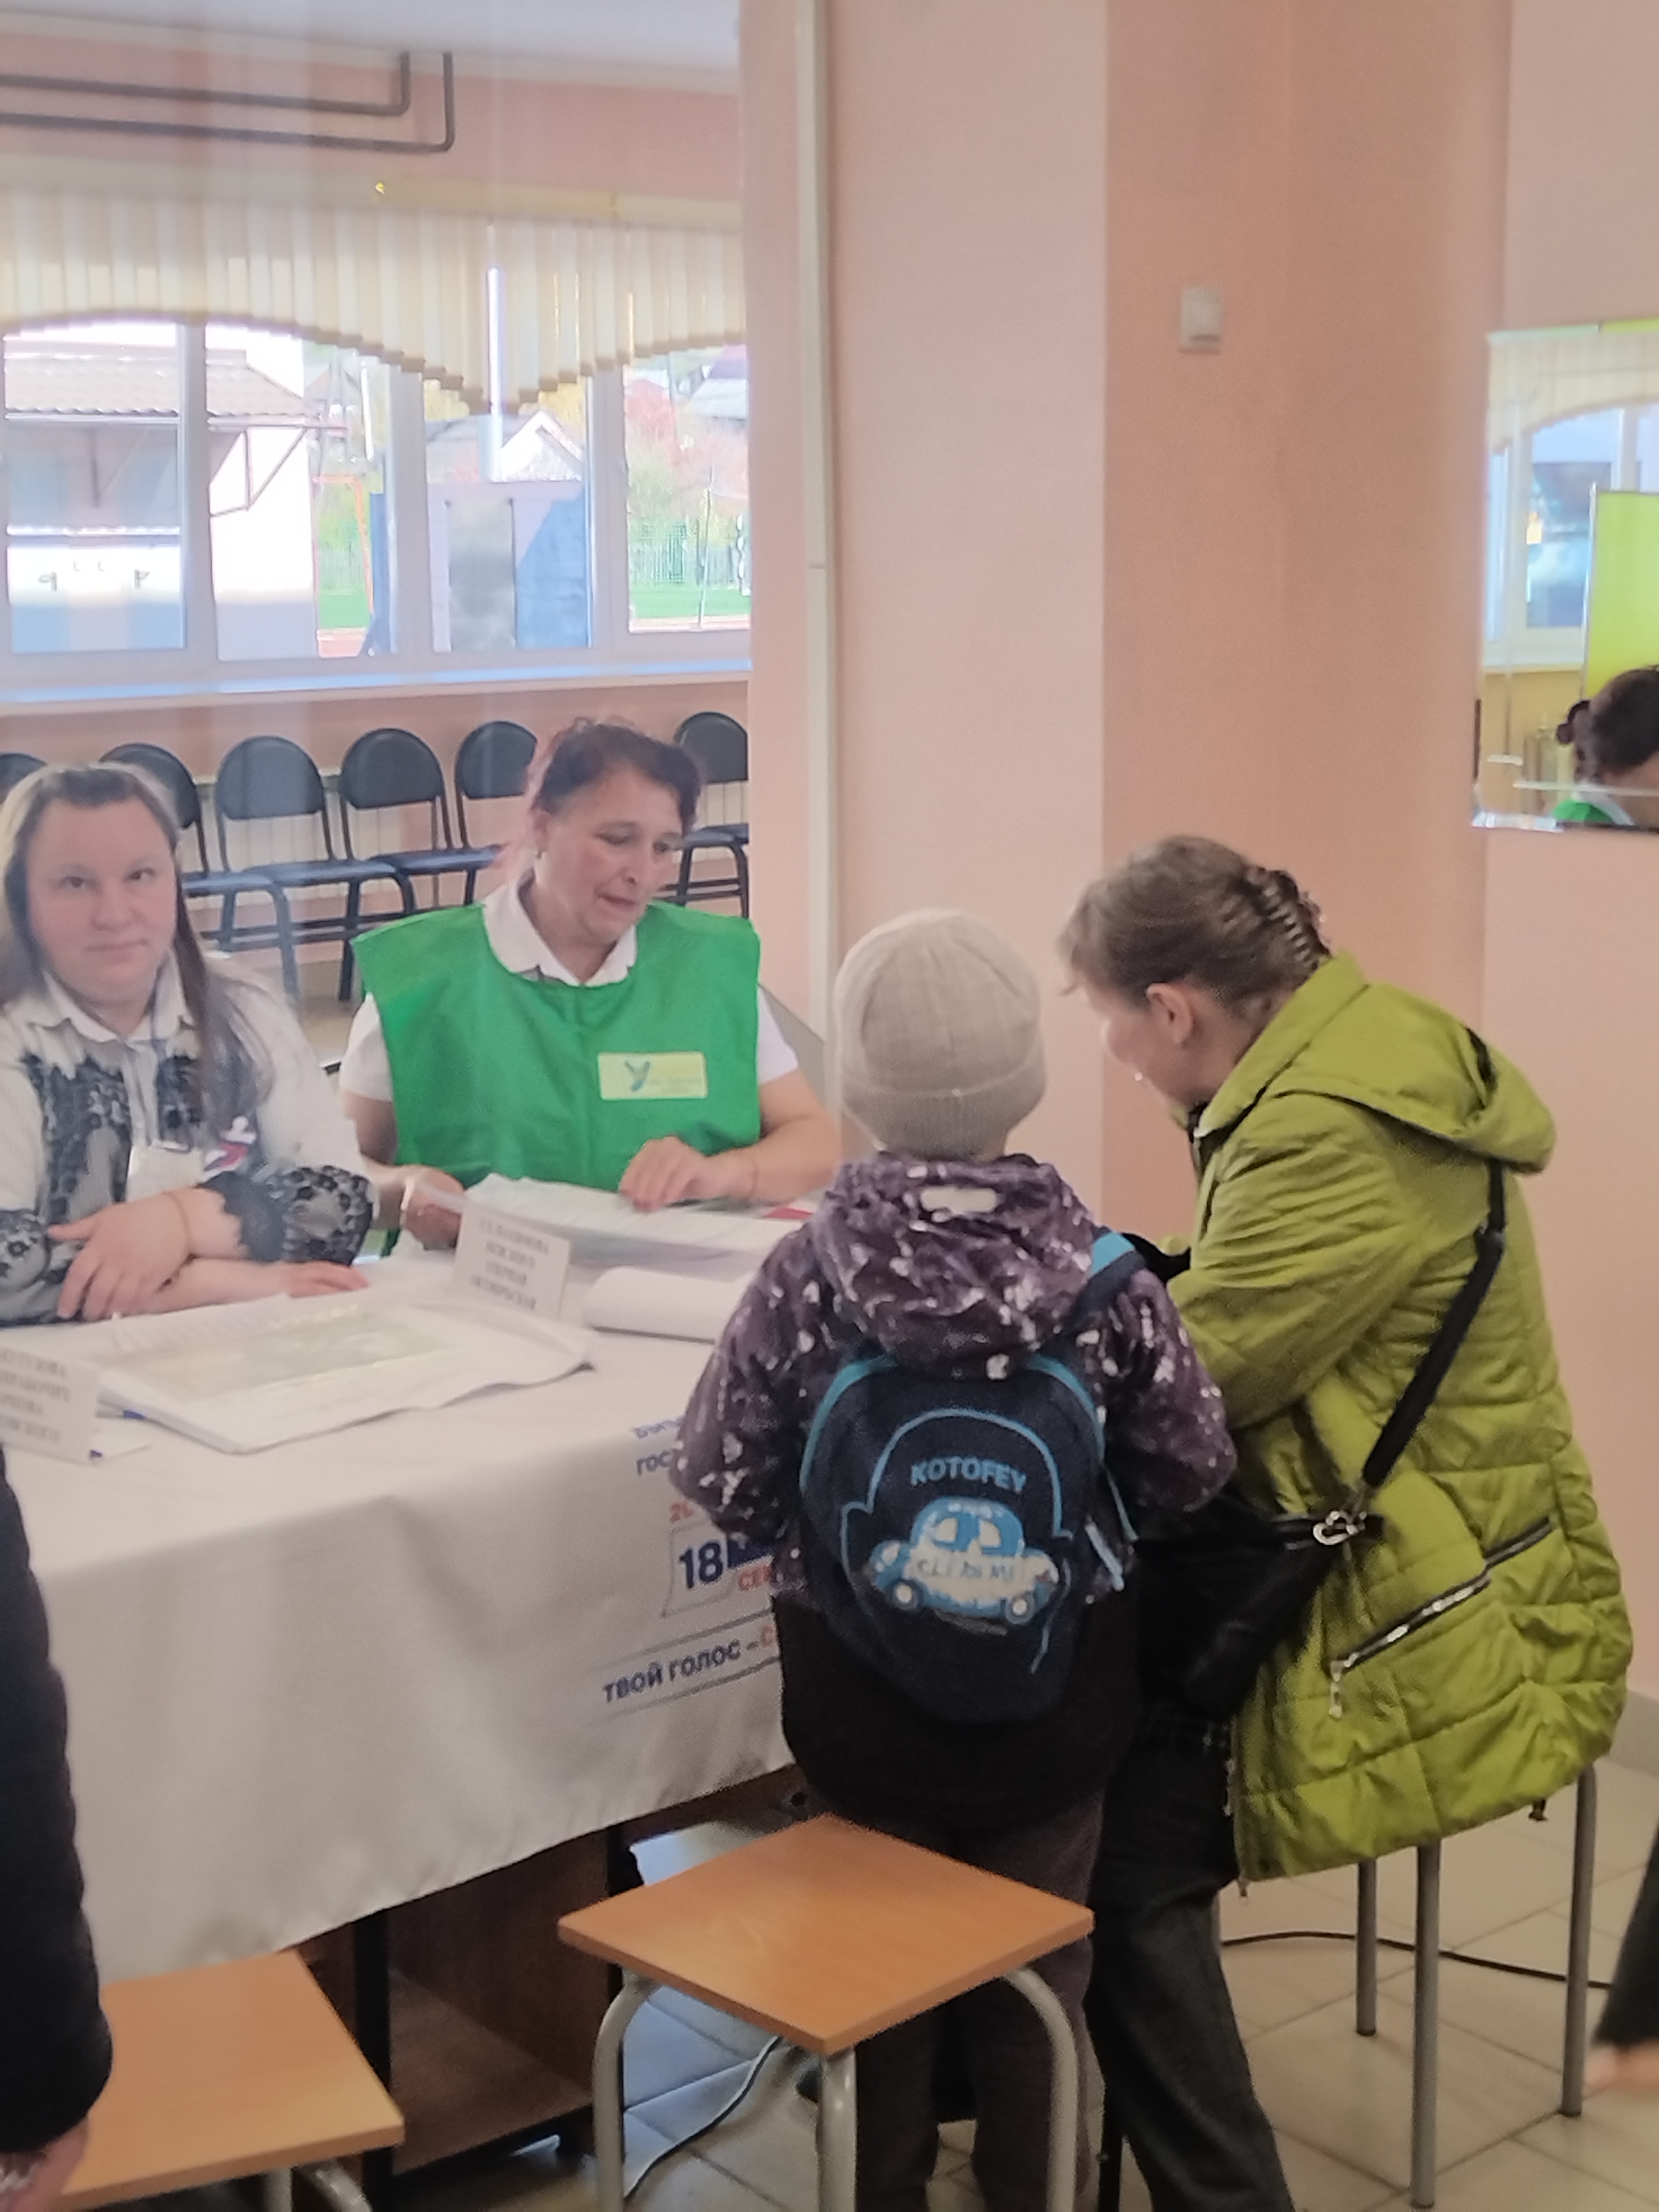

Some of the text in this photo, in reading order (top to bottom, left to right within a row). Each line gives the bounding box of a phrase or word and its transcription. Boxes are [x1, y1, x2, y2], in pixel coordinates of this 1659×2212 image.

[636, 1449, 674, 1476] ГОС
[910, 1455, 1027, 1493] KOTOFEY
[679, 1541, 723, 1589] 18
[605, 1661, 663, 1703] ТВОЙ
[669, 1639, 741, 1682] ГОЛОС
[760, 1624, 776, 1647] С
